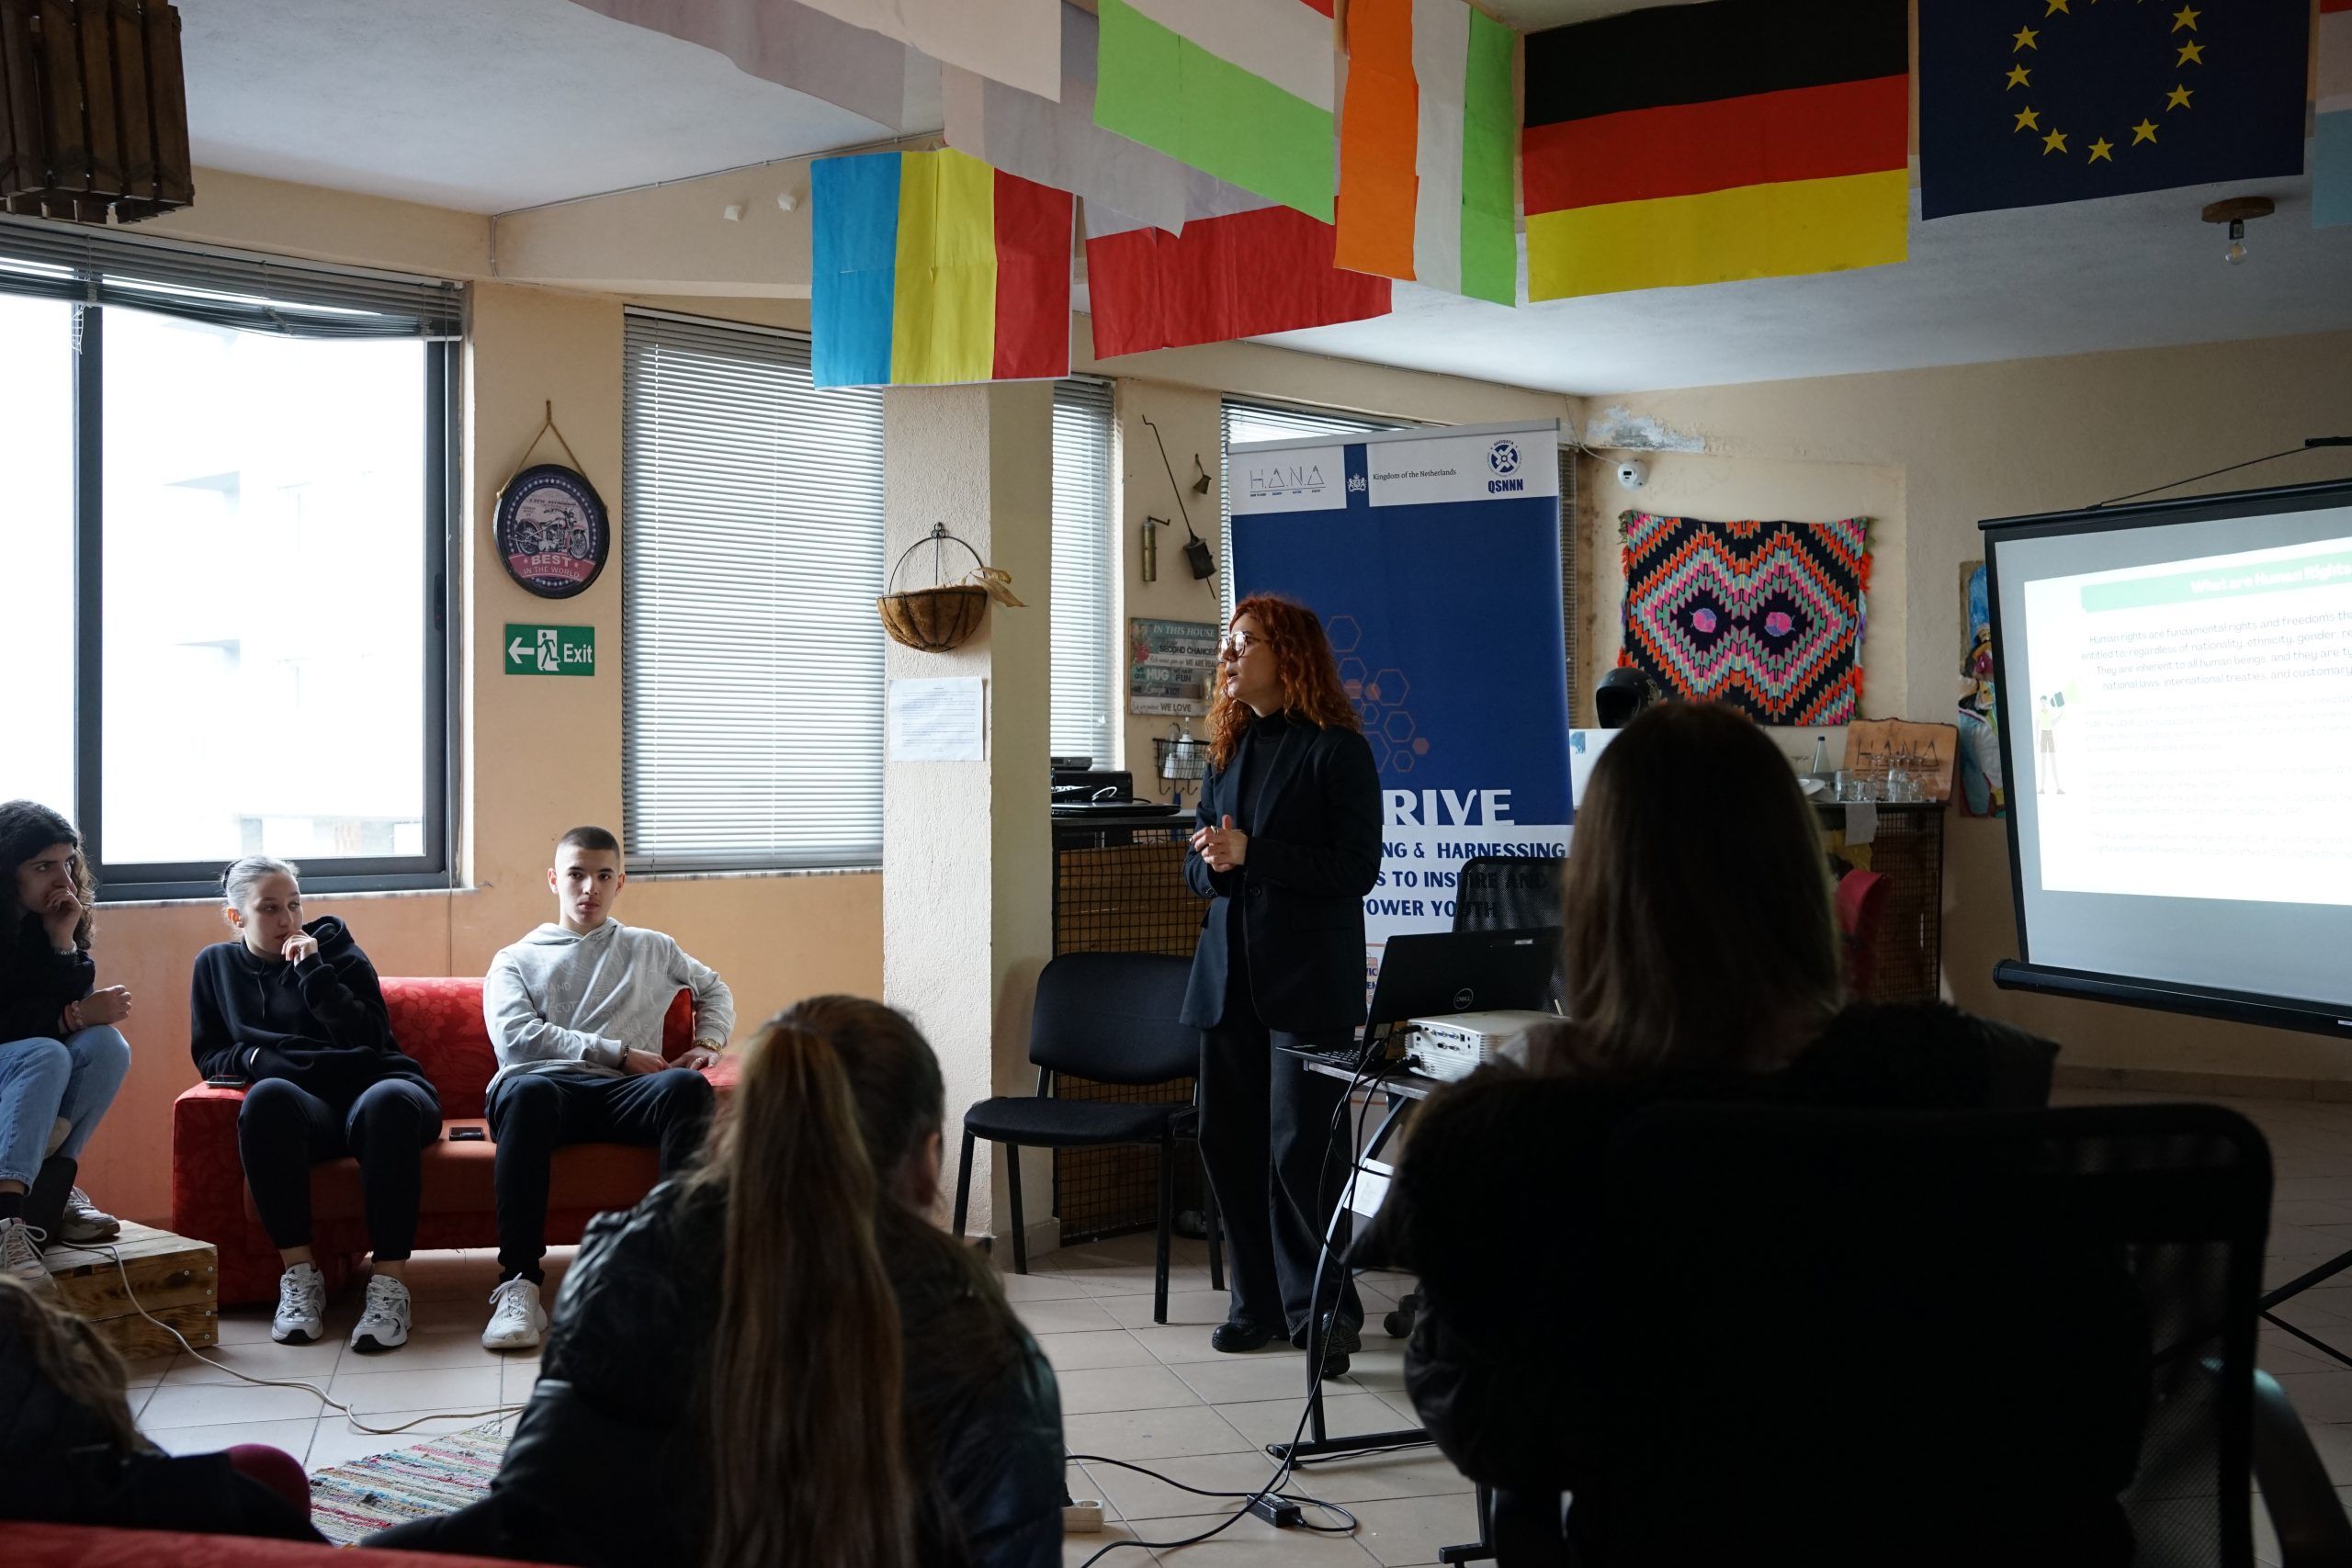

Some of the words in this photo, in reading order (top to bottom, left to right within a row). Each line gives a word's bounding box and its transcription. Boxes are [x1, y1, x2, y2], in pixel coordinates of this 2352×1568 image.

[1373, 472, 1400, 480] Kingdom
[1408, 469, 1419, 478] the
[1419, 468, 1457, 478] Netherlands
[1487, 479, 1524, 493] QSNNN
[531, 554, 572, 568] BEST
[524, 567, 533, 575] IN
[550, 567, 581, 579] WORLD
[2190, 579, 2228, 593] What
[1167, 626, 1185, 635] THIS
[1187, 627, 1216, 637] HOUSE
[2089, 634, 2119, 645] Human
[2120, 632, 2147, 643] rights
[2149, 630, 2164, 639] are
[2166, 622, 2225, 638] fundamental
[2228, 621, 2257, 634] rights
[2260, 618, 2279, 628] and
[2282, 614, 2335, 626] freedoms
[563, 643, 594, 663] Exit
[1159, 645, 1185, 654] SECOND
[1186, 646, 1217, 656] CHANCES
[2081, 650, 2114, 661] entitled
[2129, 645, 2177, 659] regardless
[2178, 642, 2188, 652] of
[2097, 665, 2117, 676] They
[2119, 665, 2133, 674] are
[2136, 660, 2175, 673] inherent
[2176, 660, 2186, 670] to
[2188, 657, 2198, 669] all
[2200, 657, 2233, 668] human
[2270, 652, 2290, 663] and
[2293, 650, 2318, 662] they
[2320, 649, 2339, 659] are
[1146, 668, 1170, 681] HUG
[2102, 678, 2138, 691] national
[2164, 672, 2223, 687] international
[2270, 668, 2290, 680] and
[2292, 663, 2352, 678] customary
[1161, 703, 1170, 711] WE
[1172, 704, 1192, 712] LOVE
[1382, 789, 1514, 825] RIVE
[1381, 841, 1408, 858] NG
[1413, 841, 1425, 859] &
[1437, 842, 1566, 860] HARNESSING
[1392, 871, 1418, 888] TO
